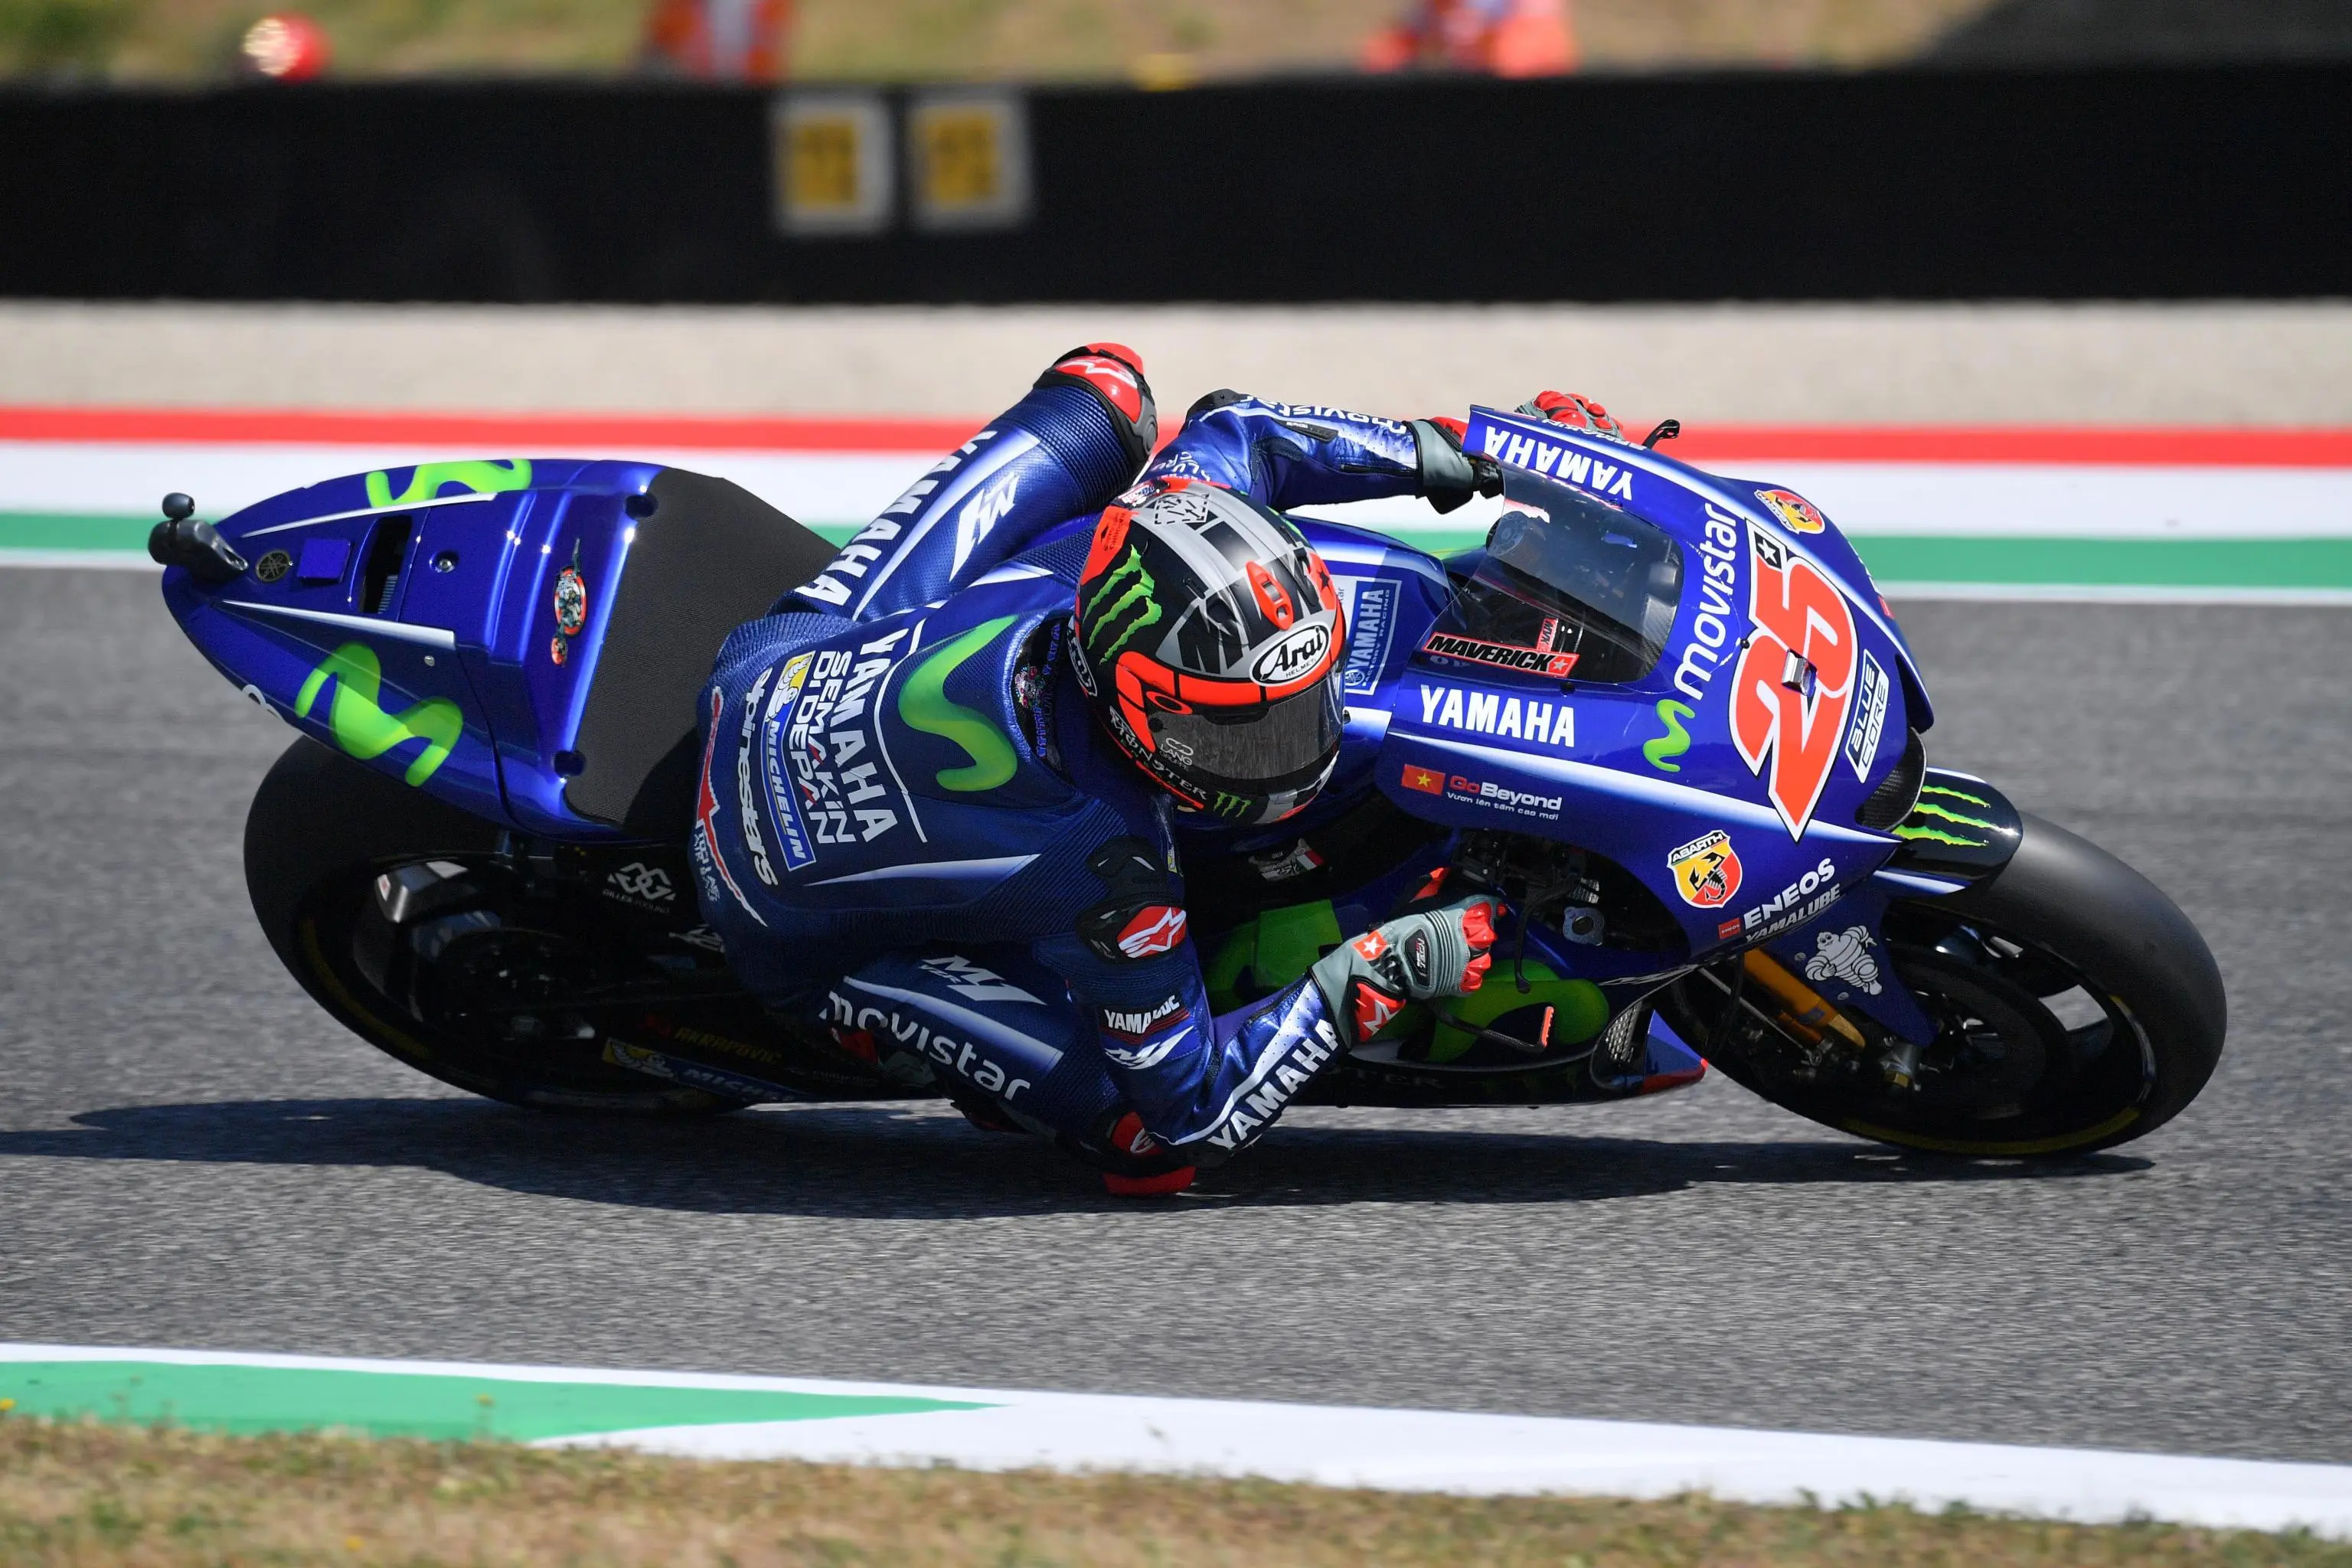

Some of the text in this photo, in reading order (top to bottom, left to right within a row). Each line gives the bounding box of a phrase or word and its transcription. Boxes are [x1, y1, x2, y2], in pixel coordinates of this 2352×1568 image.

[1485, 426, 1633, 501] YAMAHA
[1347, 589, 1383, 668] YAMAHA
[1378, 589, 1390, 637] RACING
[1674, 503, 1737, 701] movistar
[1260, 627, 1323, 681] Arai
[1426, 635, 1556, 672] MAVERICK
[1729, 518, 1858, 843] 25
[807, 651, 856, 844] SEMAKIN
[829, 628, 909, 842] YAMAHA
[1420, 684, 1575, 747] YAMAHA
[1851, 663, 1875, 753] BLUE
[1862, 681, 1886, 769] CORE
[767, 720, 806, 859] MICHELIN
[789, 694, 835, 844] DEPAN
[1111, 716, 1207, 801] MONSTER
[1517, 808, 1536, 817] cao
[1672, 833, 1723, 863] ABARTH
[1743, 858, 1835, 929] ENEOS
[1746, 883, 1841, 942] YAMALUBE
[1206, 1019, 1338, 1150] YAMAHA
